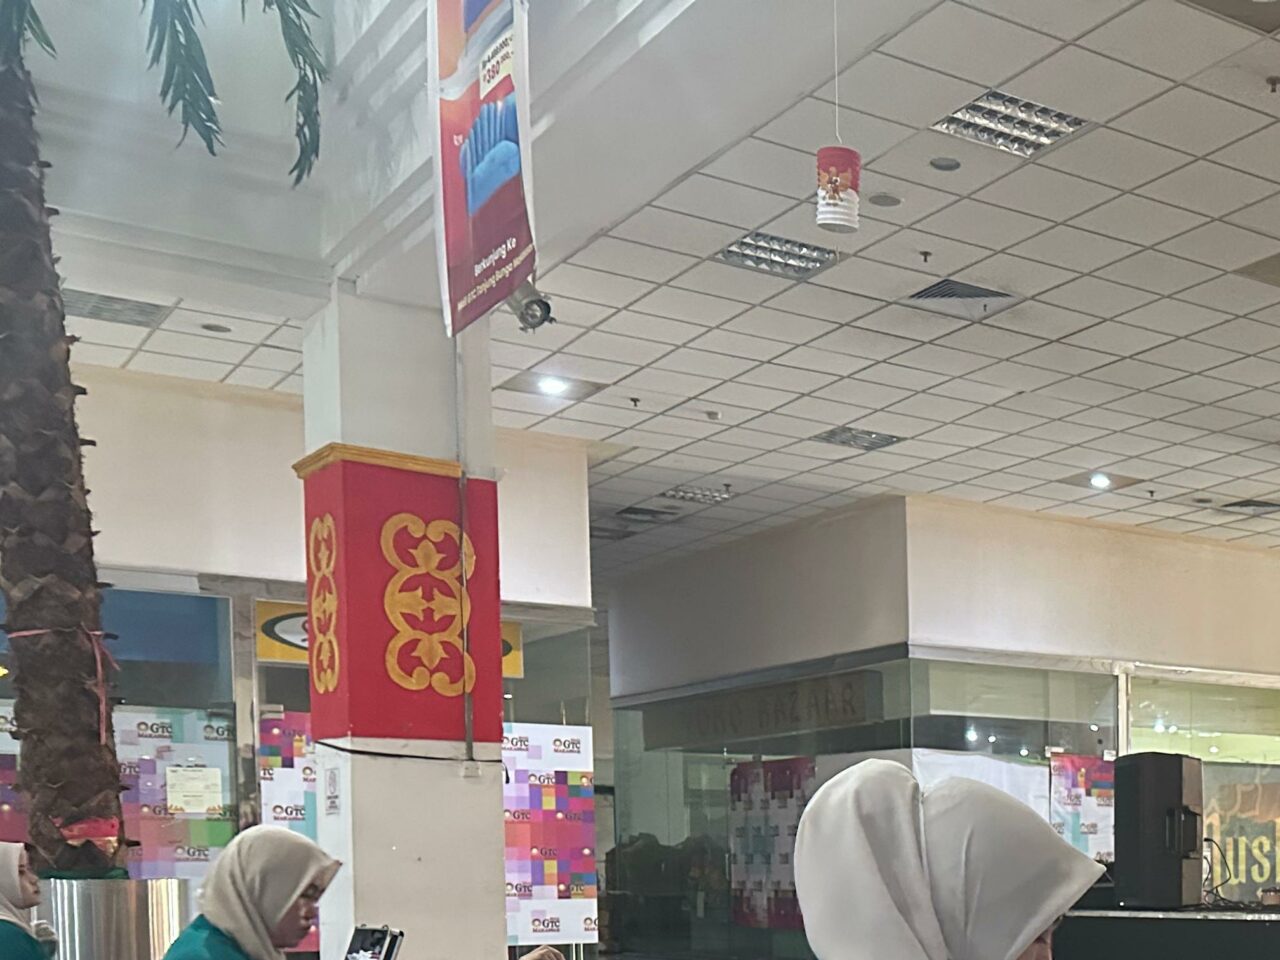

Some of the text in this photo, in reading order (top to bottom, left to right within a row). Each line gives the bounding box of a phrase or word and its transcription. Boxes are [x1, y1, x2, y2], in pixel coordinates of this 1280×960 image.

[150, 722, 173, 734] GTC
[510, 737, 529, 748] GTC
[562, 739, 582, 750] GTC
[284, 805, 306, 817] GTC
[512, 809, 532, 820] GTC
[514, 883, 533, 893] GTC
[541, 919, 561, 929] GTC
